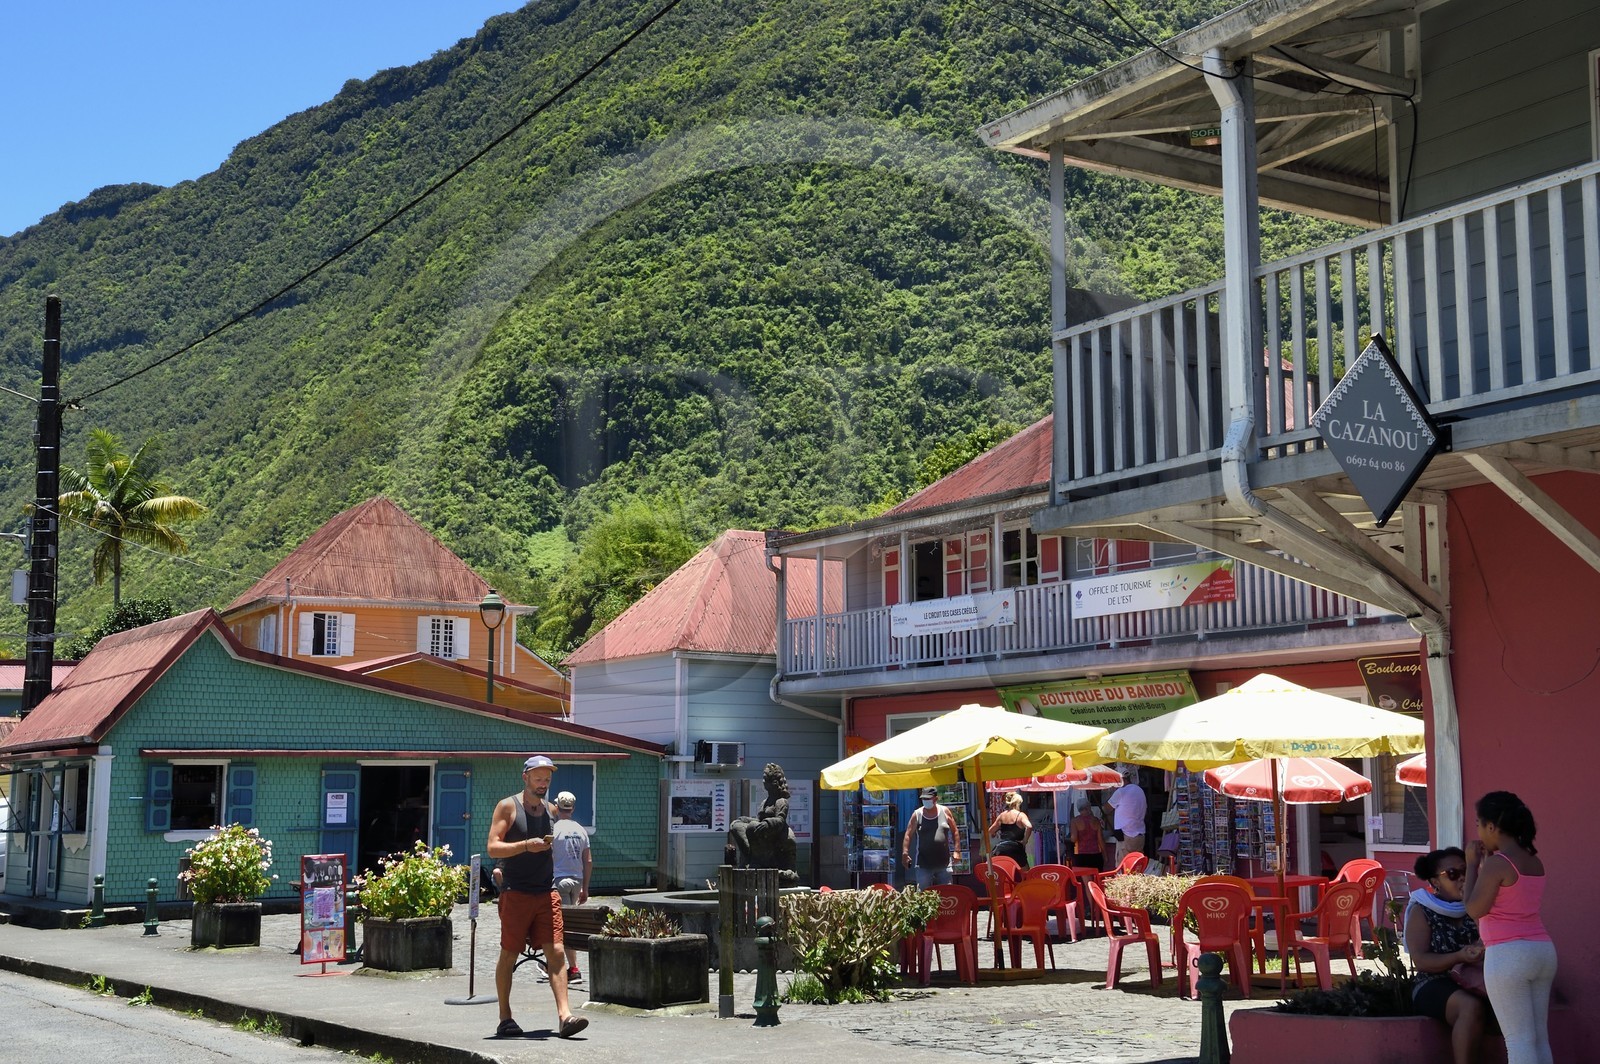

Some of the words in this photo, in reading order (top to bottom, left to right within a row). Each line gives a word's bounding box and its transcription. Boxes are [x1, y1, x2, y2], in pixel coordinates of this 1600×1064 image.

[1192, 128, 1221, 138] SORT
[1363, 400, 1386, 421] LA
[1328, 420, 1418, 451] CAZANOU
[1346, 454, 1366, 467] 0692
[1369, 458, 1379, 470] 64
[1382, 461, 1392, 470] 00
[1395, 461, 1405, 472] 86
[1089, 586, 1108, 596] OFFICE
[1110, 584, 1118, 593] DE
[1120, 580, 1152, 591] TOURISME
[1108, 596, 1115, 606] DE
[1118, 595, 1132, 604] L'EST
[929, 611, 941, 619] CIRCUIT
[1038, 688, 1104, 706] BOUTIQUE
[1104, 686, 1124, 700] DU
[1126, 682, 1186, 699] BAMBOU
[1070, 706, 1095, 715] Création
[1097, 704, 1126, 713] Artisanale
